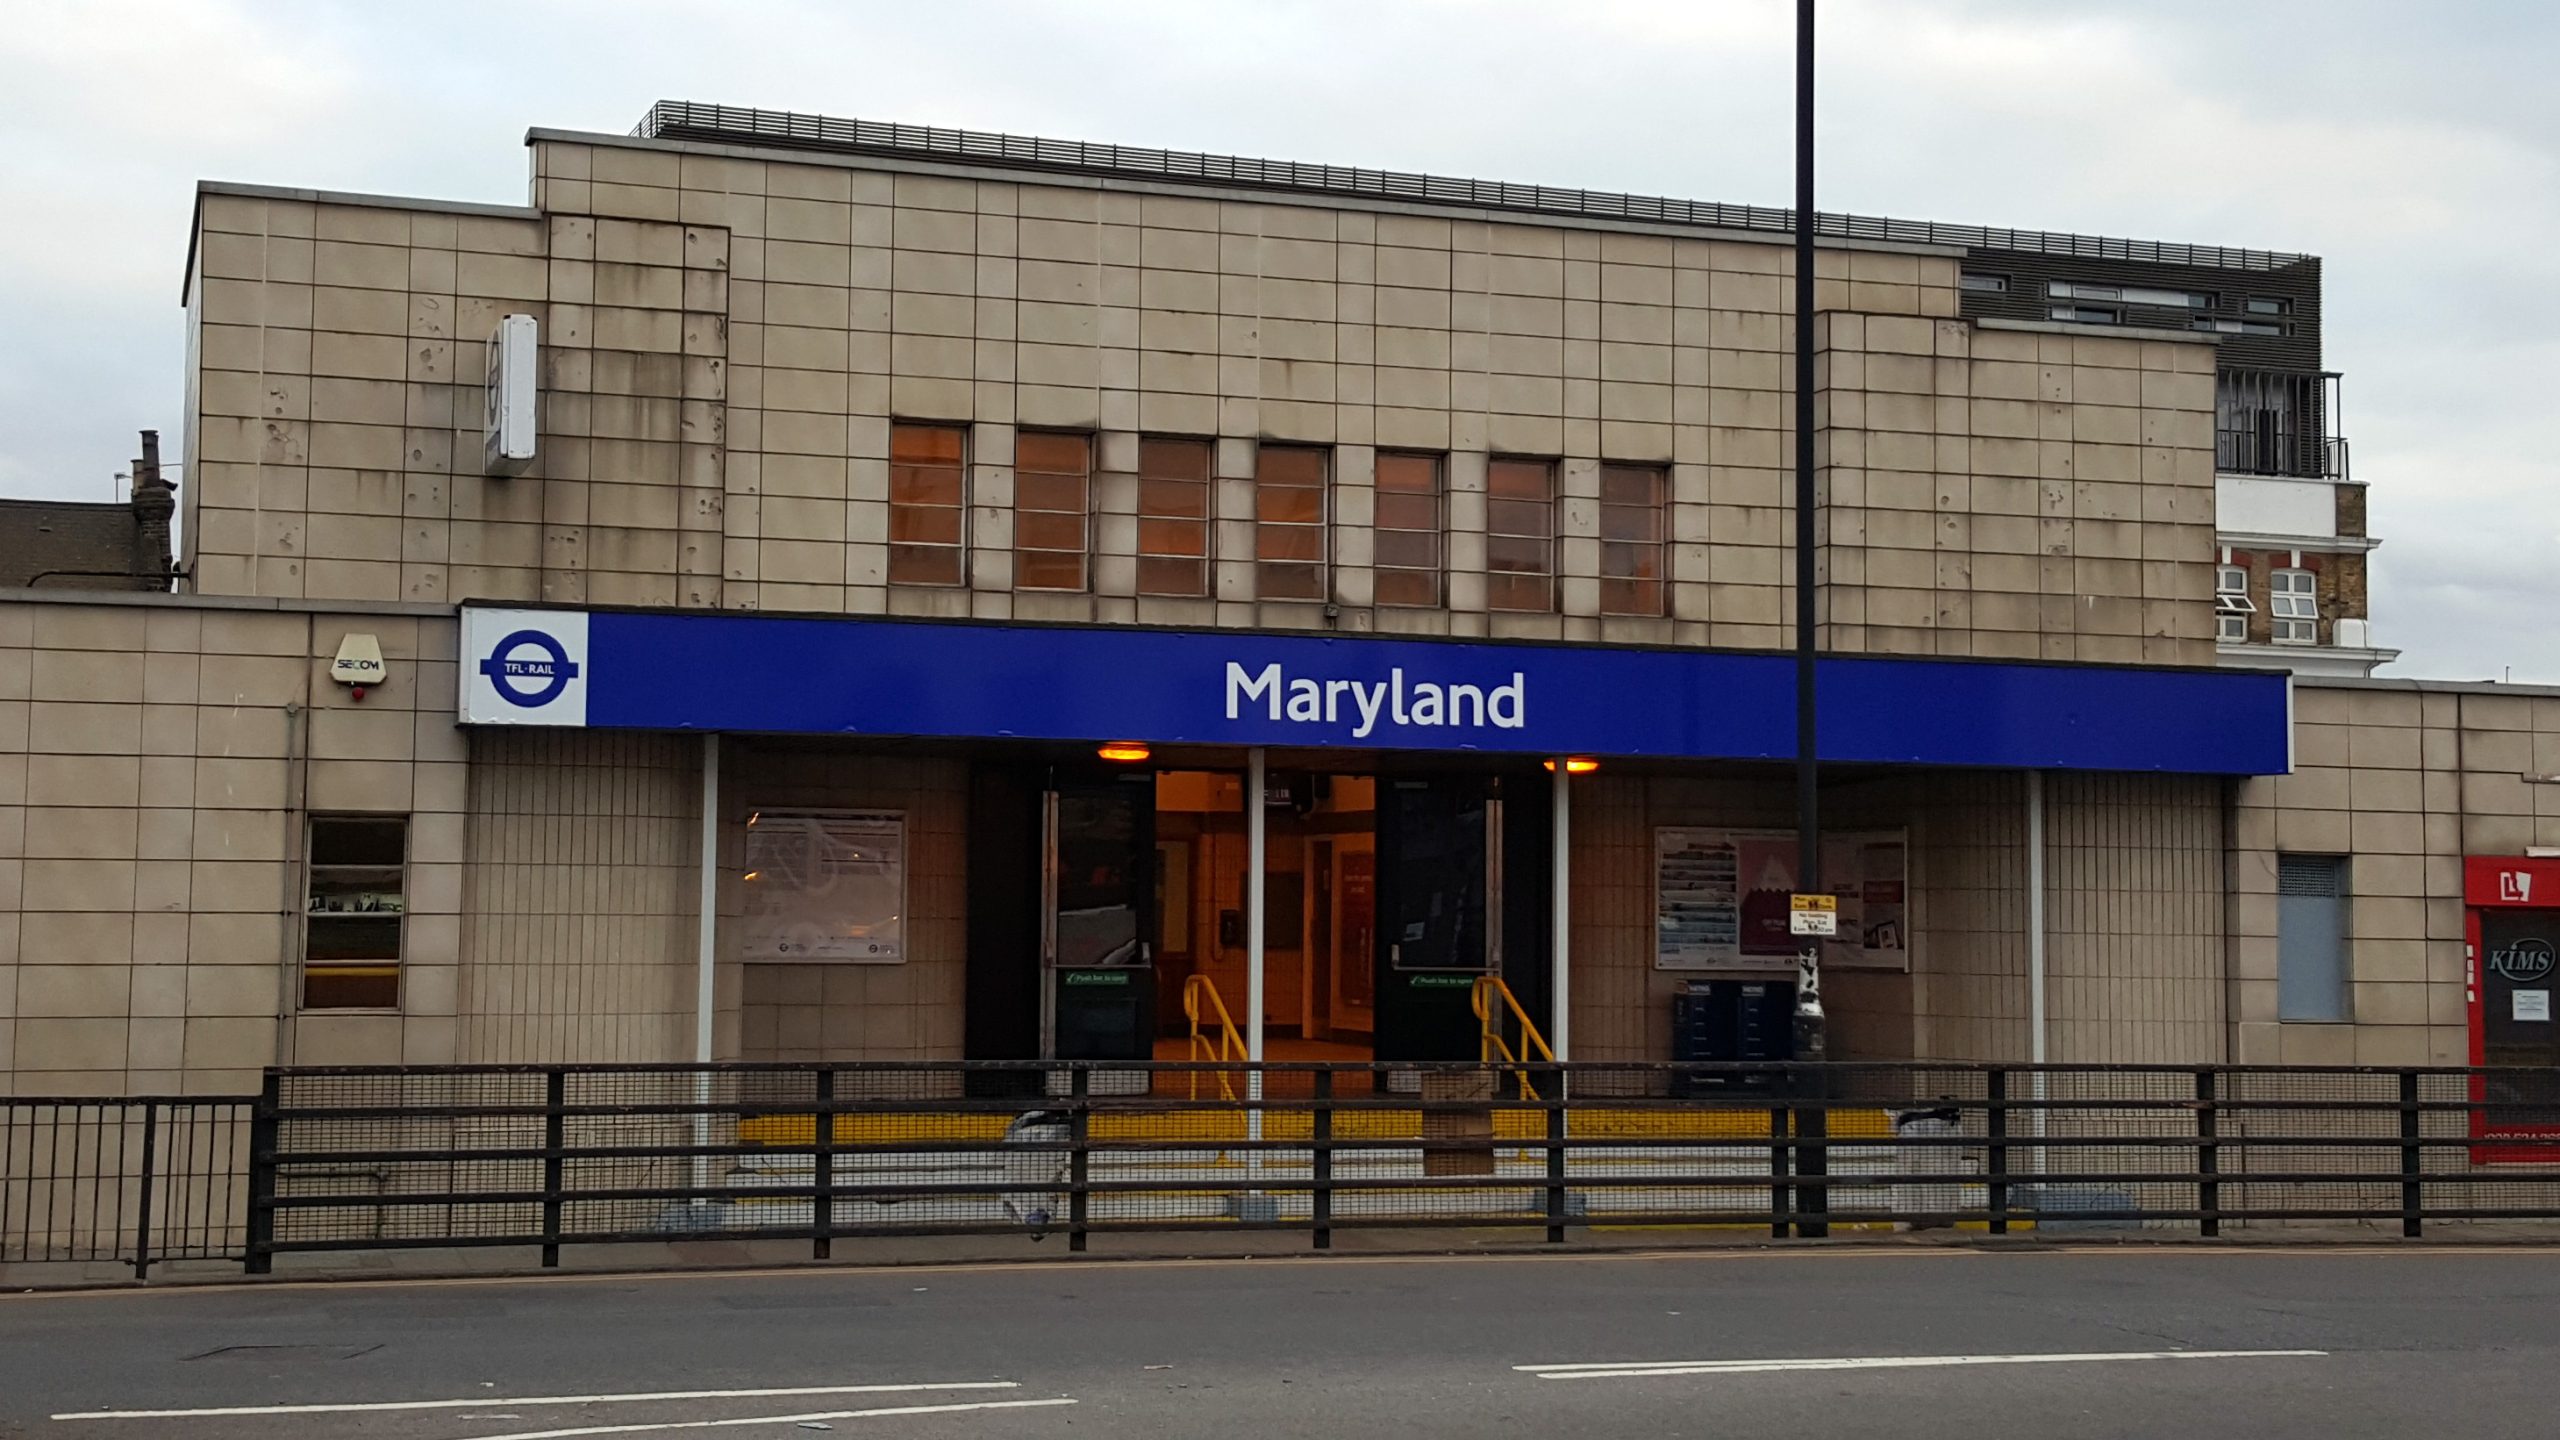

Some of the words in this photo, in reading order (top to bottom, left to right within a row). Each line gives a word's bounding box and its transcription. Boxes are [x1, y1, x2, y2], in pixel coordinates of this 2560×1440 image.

[337, 659, 380, 671] SECOM
[1226, 662, 1524, 737] Maryland
[2490, 944, 2550, 971] KIMS
